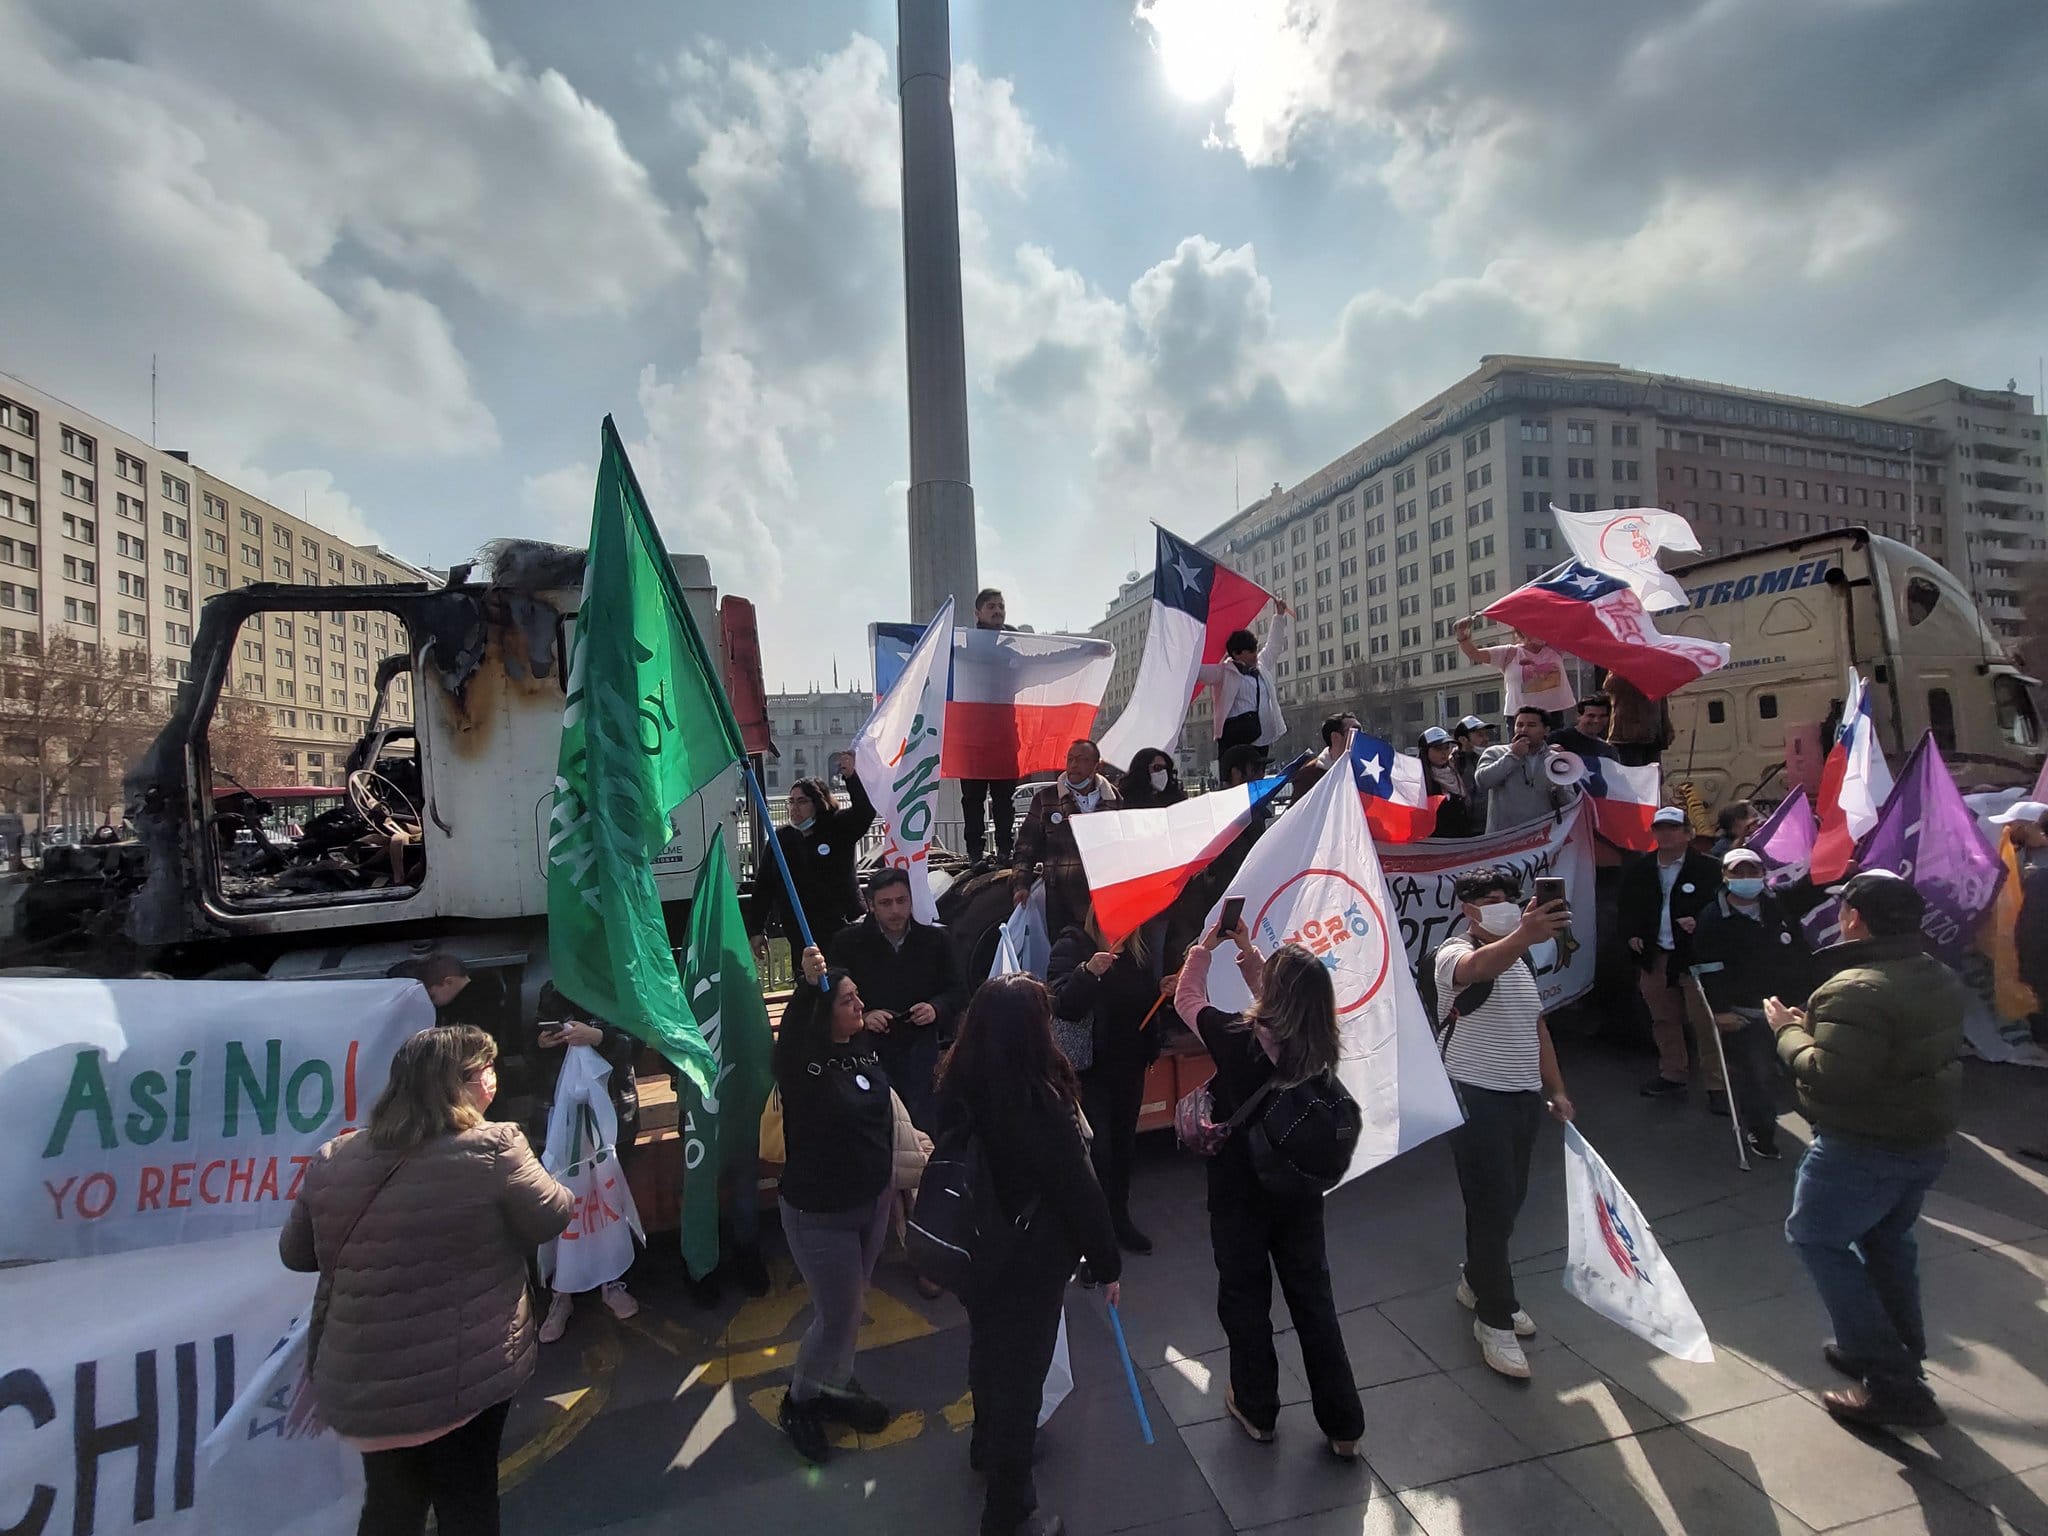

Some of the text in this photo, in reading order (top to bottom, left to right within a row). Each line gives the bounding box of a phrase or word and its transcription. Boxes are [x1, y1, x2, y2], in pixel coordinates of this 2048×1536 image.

[1324, 915, 1352, 945] RE
[1344, 902, 1369, 937] YO
[1303, 920, 1332, 955] CH
[42, 1050, 197, 1158] Así
[44, 1156, 312, 1219] YO RECHAZ
